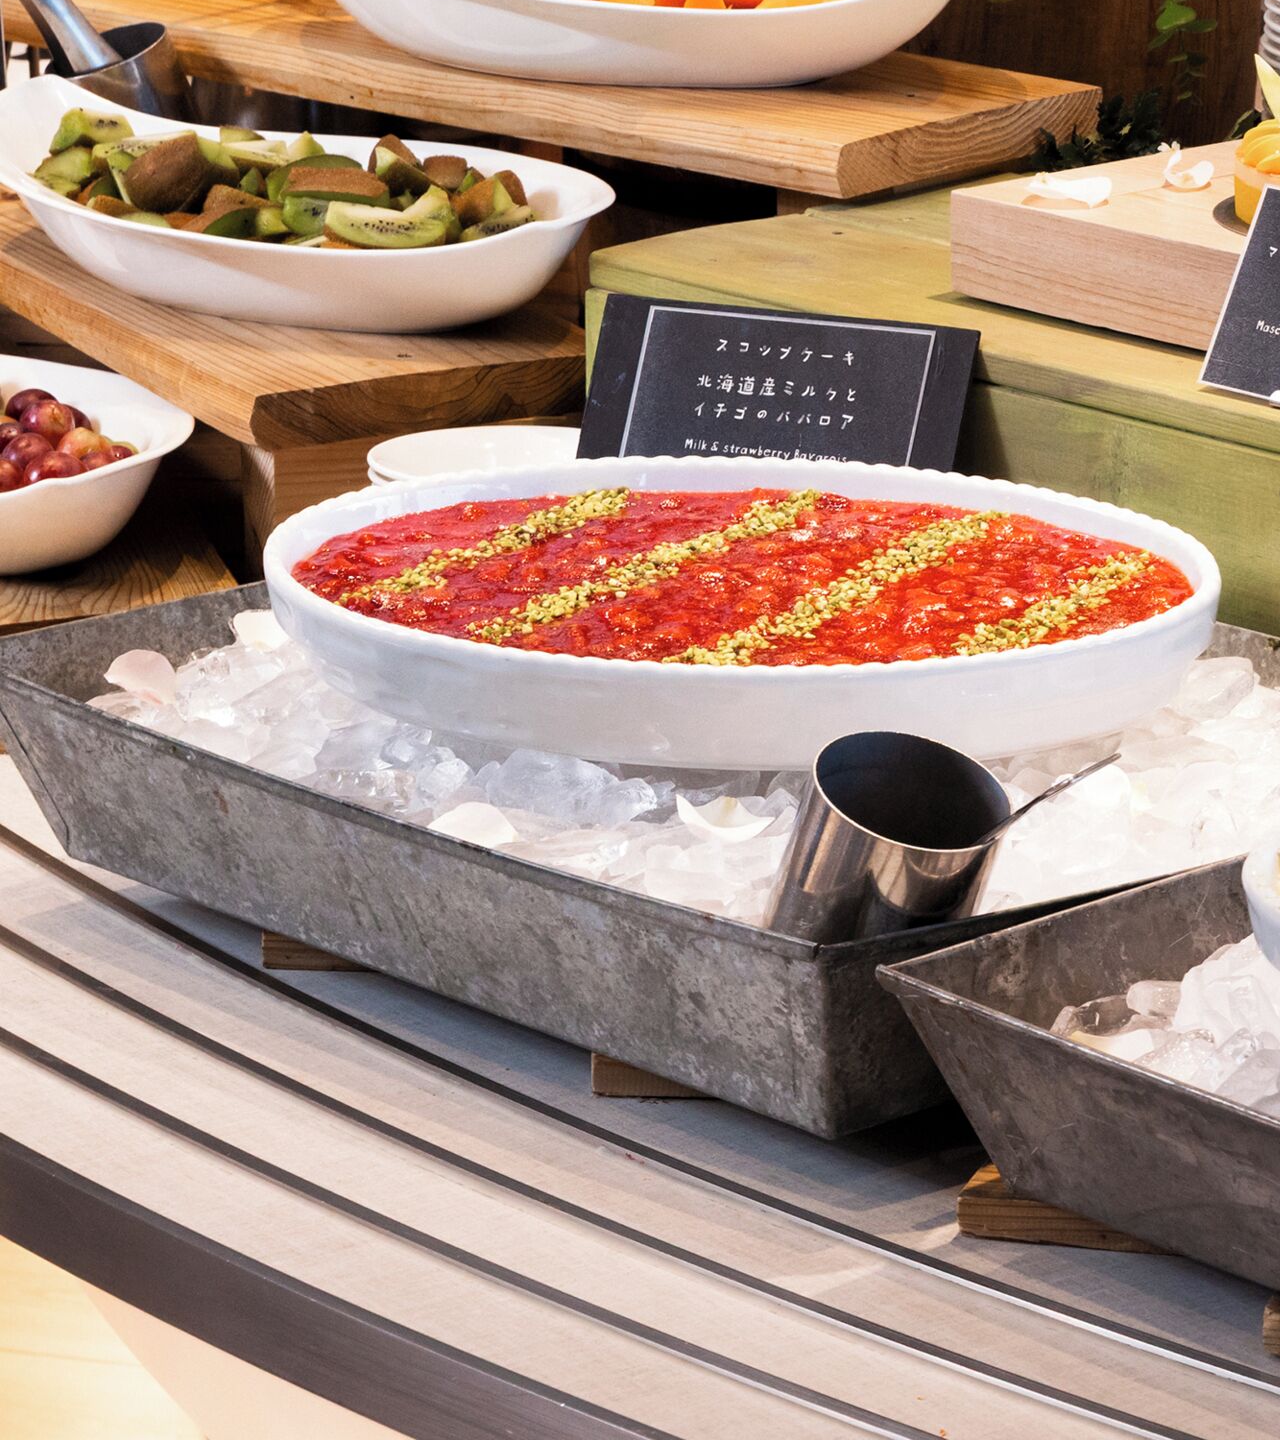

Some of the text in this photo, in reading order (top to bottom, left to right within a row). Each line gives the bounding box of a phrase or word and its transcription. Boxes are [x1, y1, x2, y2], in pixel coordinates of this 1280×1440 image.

[696, 372, 857, 403] 北海道産ミルクと
[693, 401, 855, 430] イチゴのババロア
[684, 437, 708, 451] Milk
[710, 441, 720, 452] &
[722, 444, 791, 460] strawberry
